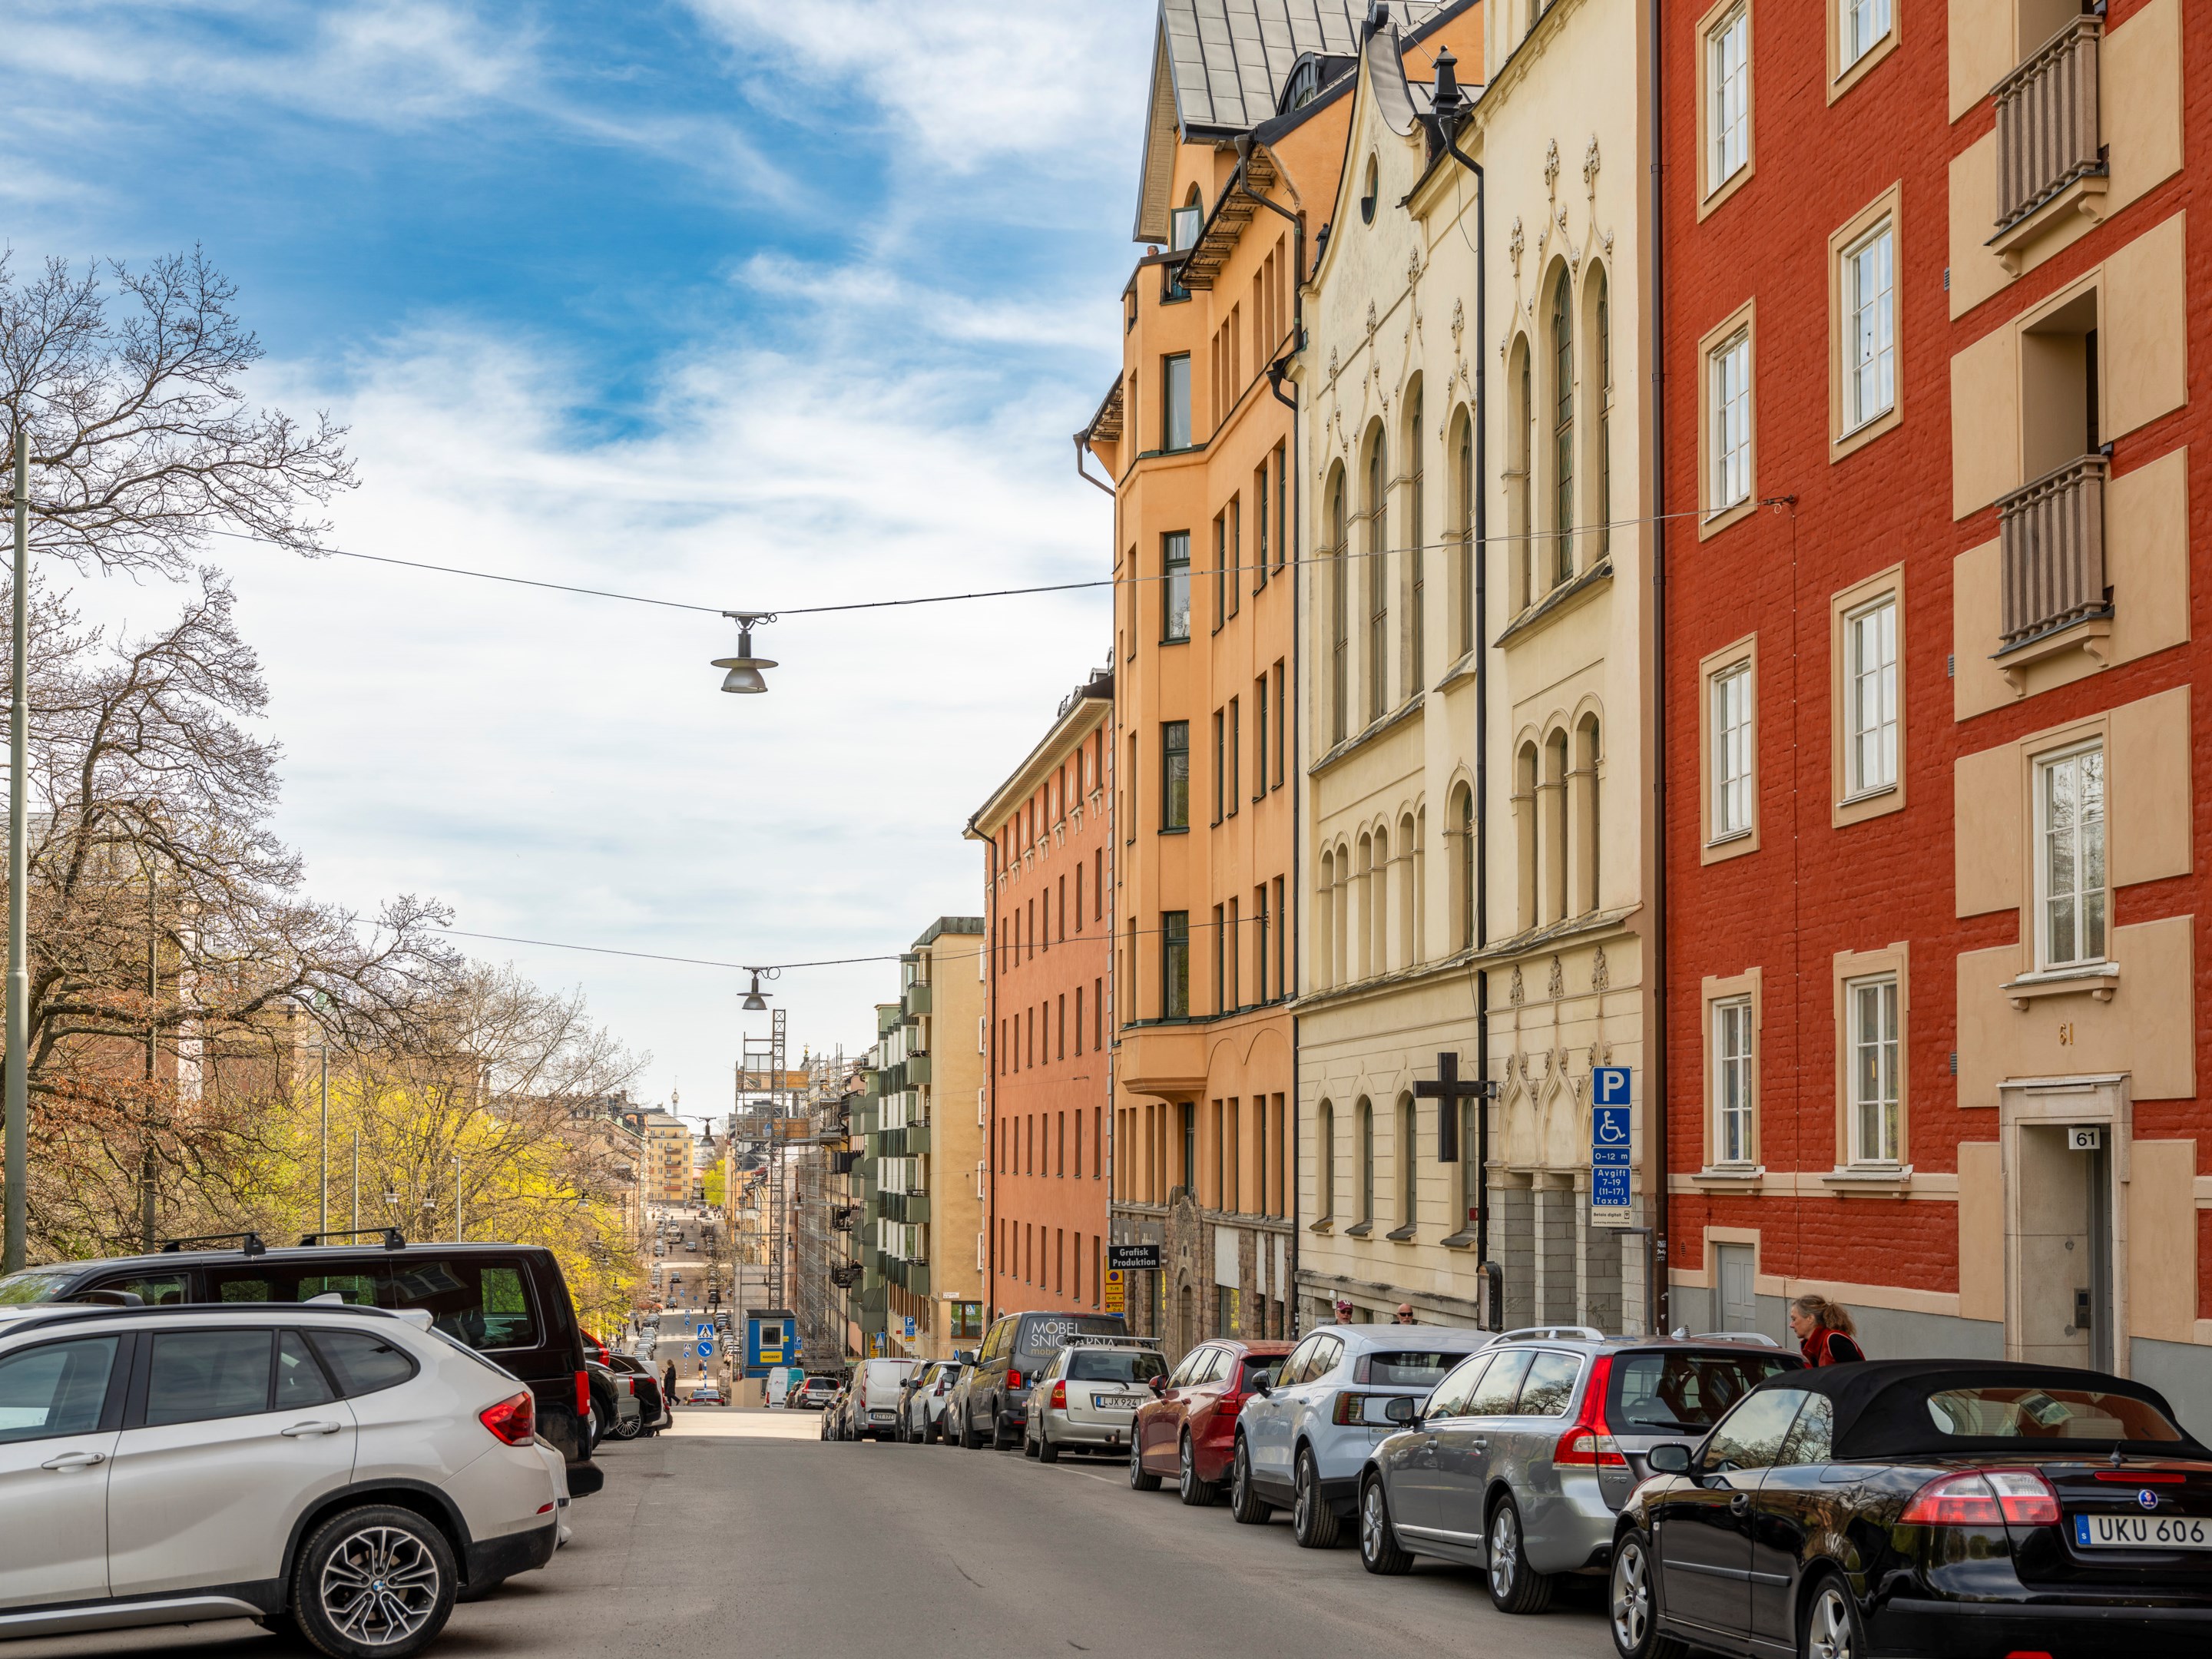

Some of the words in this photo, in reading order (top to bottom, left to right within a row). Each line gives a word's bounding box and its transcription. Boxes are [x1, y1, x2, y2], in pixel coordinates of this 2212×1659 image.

[2059, 1023, 2074, 1046] 61
[1603, 1071, 1624, 1101] P
[2076, 1131, 2095, 1147] 61
[1598, 1169, 1626, 1177] Avgift
[1119, 1247, 1149, 1257] Grafisk
[1112, 1258, 1157, 1267] Produktion
[907, 1317, 914, 1326] P
[1031, 1318, 1081, 1336] MÖBEL
[1103, 1398, 1119, 1406] LJX
[2098, 1518, 2147, 1541] UKU
[2156, 1519, 2205, 1543] 606
